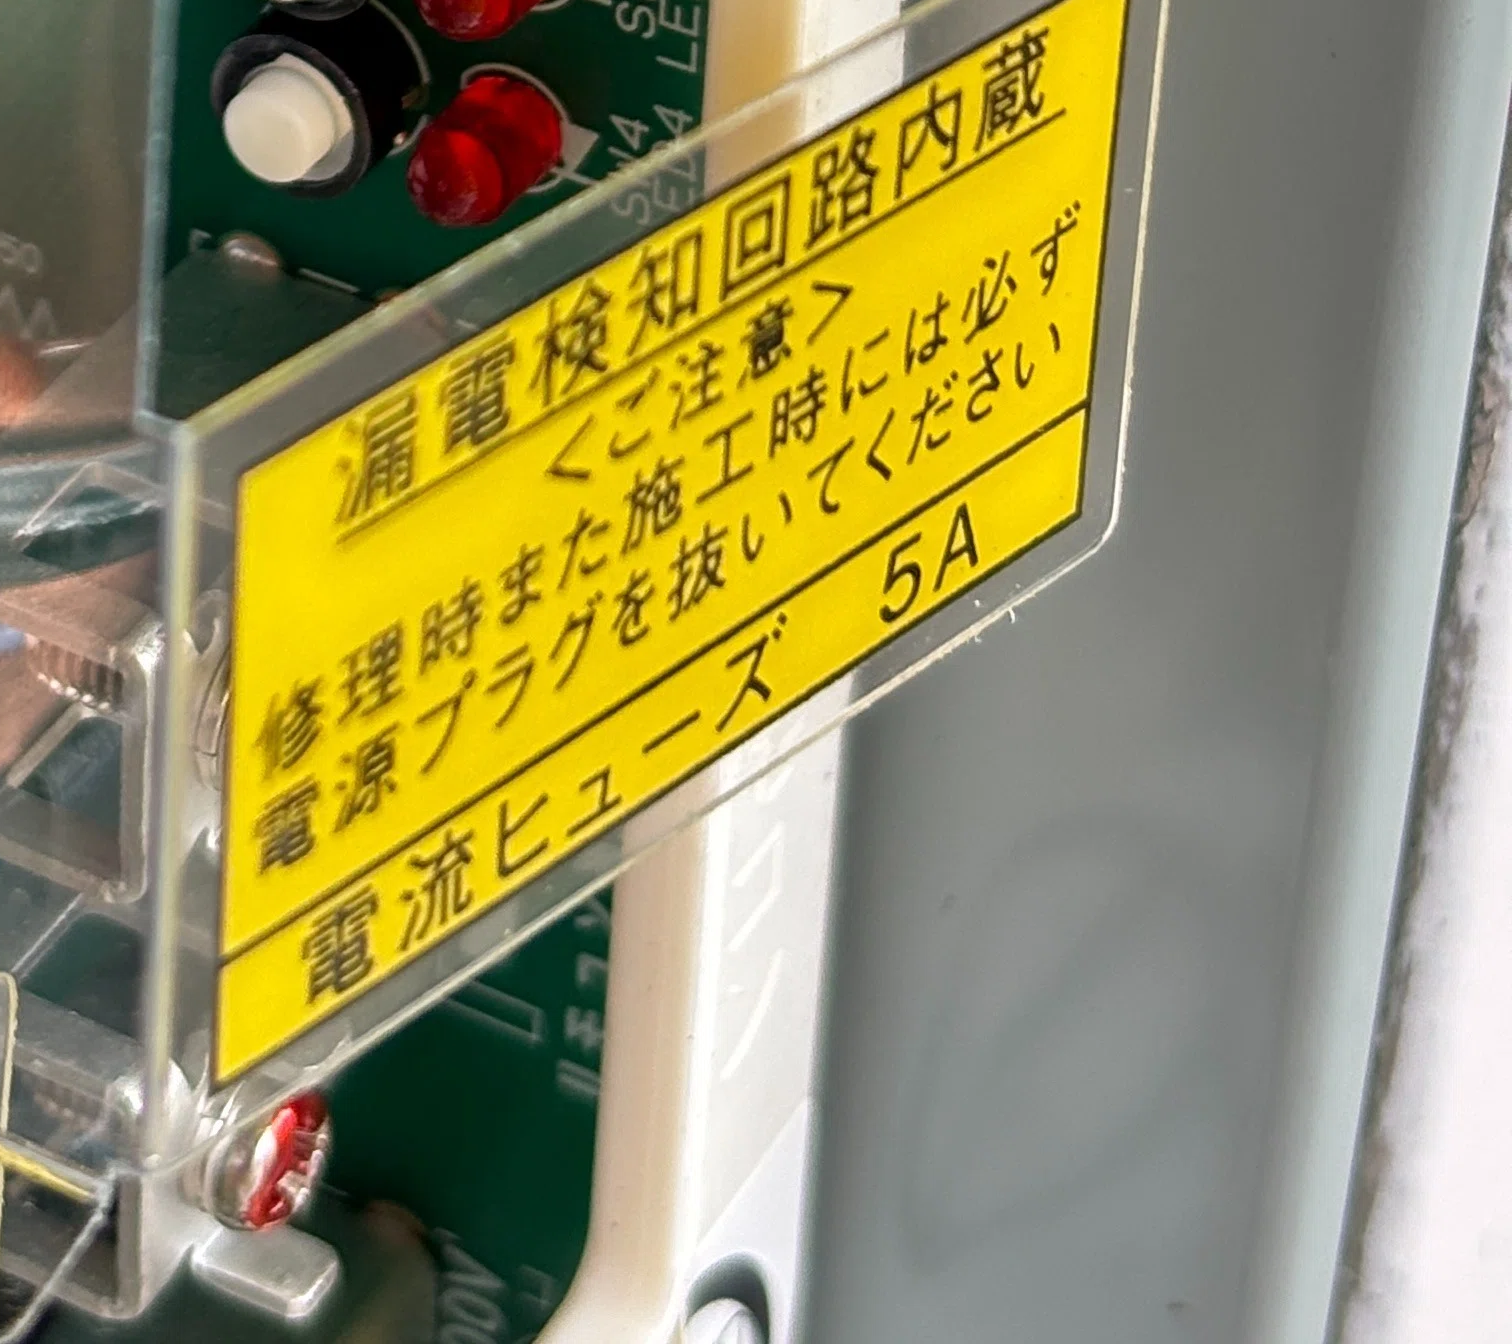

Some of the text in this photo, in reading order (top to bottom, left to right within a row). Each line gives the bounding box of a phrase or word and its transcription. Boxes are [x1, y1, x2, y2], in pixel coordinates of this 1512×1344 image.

[255, 201, 1081, 779] 修理時また施工時には必ず
[336, 26, 1050, 523] 漏電検知回路内蔵
[253, 322, 1060, 874] 電源プラグを抜いてください
[301, 503, 978, 1003] 電流ヒューズ 5A
